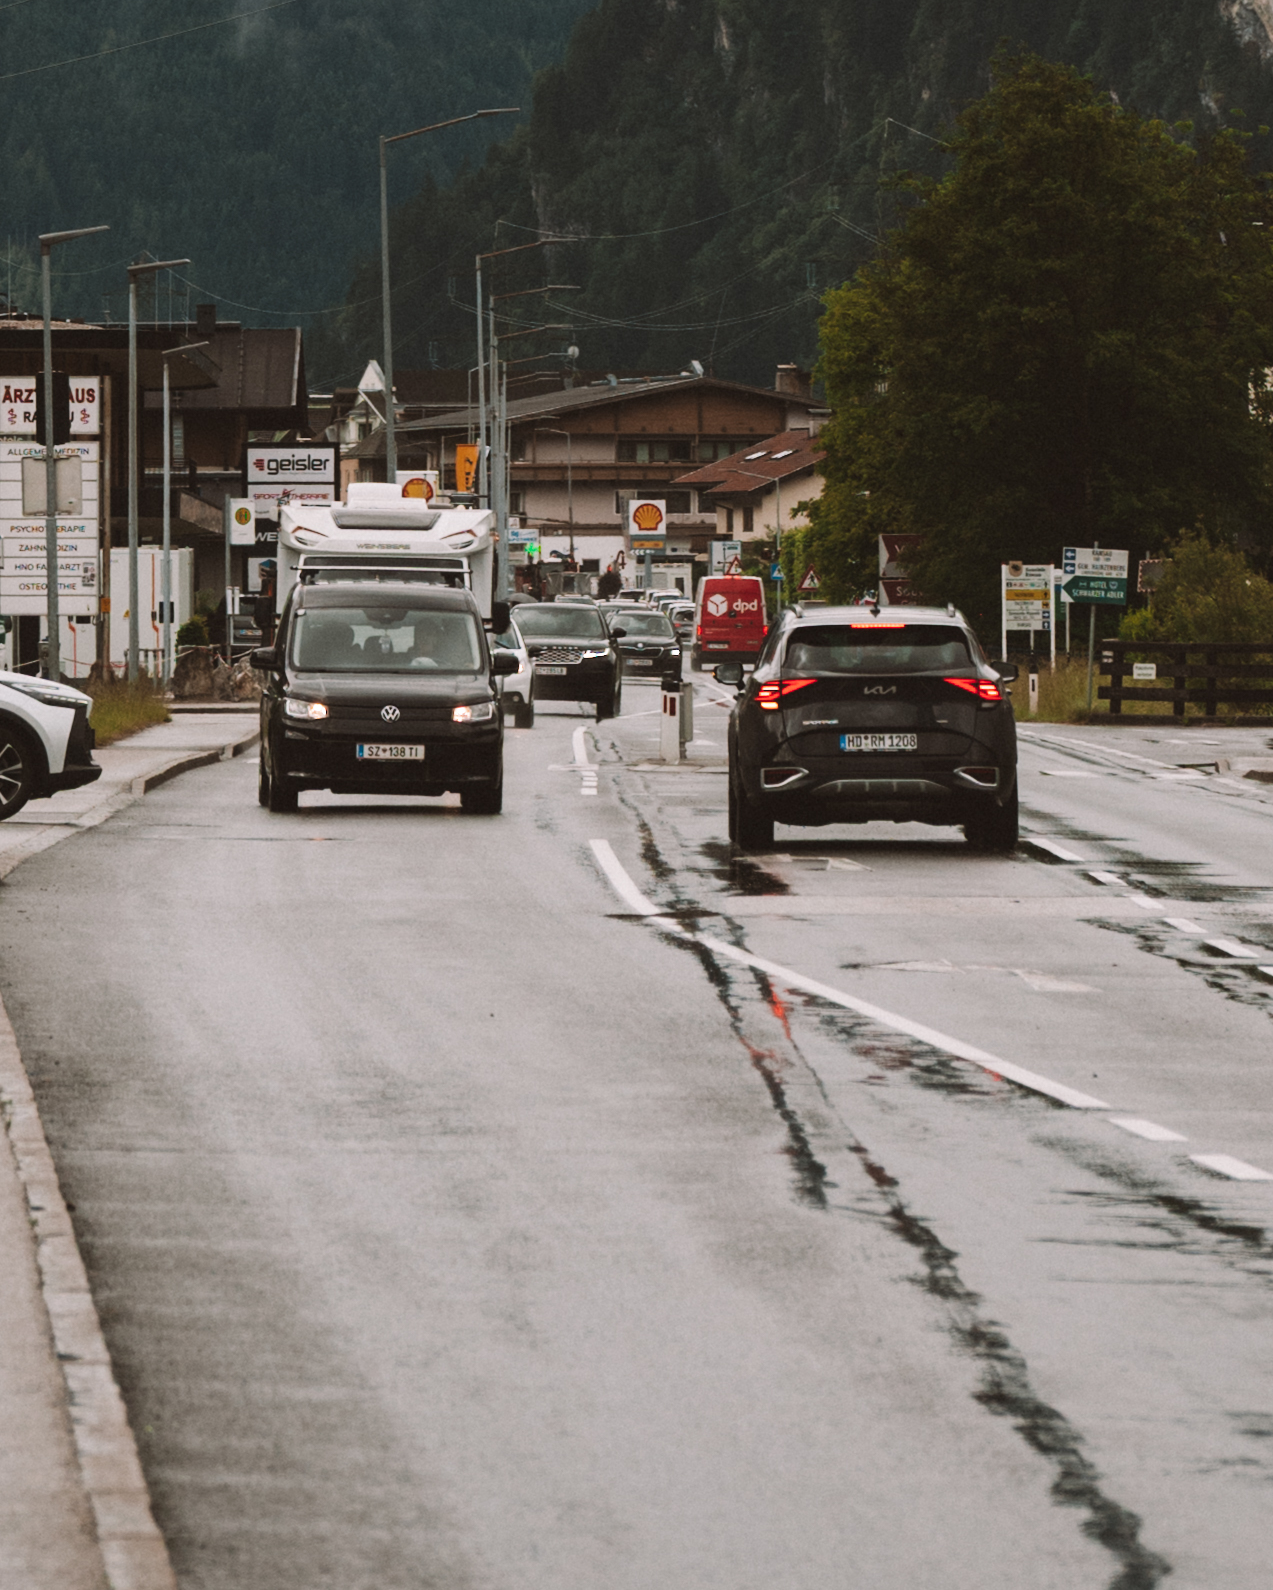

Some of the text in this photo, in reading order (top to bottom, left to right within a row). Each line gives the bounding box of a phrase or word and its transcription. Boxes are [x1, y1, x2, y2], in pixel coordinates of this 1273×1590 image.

[2, 385, 96, 403] ÄRZUS
[7, 448, 90, 456] ALLGEMEMEDIZIN
[267, 454, 330, 475] geisler
[10, 525, 86, 533] PSYCHOERAPIE
[18, 544, 78, 552] ZAHNDIZIN
[14, 563, 81, 572] HNO FAARZT
[18, 582, 77, 591] OSTEOTHIE
[732, 599, 758, 614] dpd
[847, 735, 917, 748] HD RM 1208
[367, 746, 418, 757] SZ 138 TI
